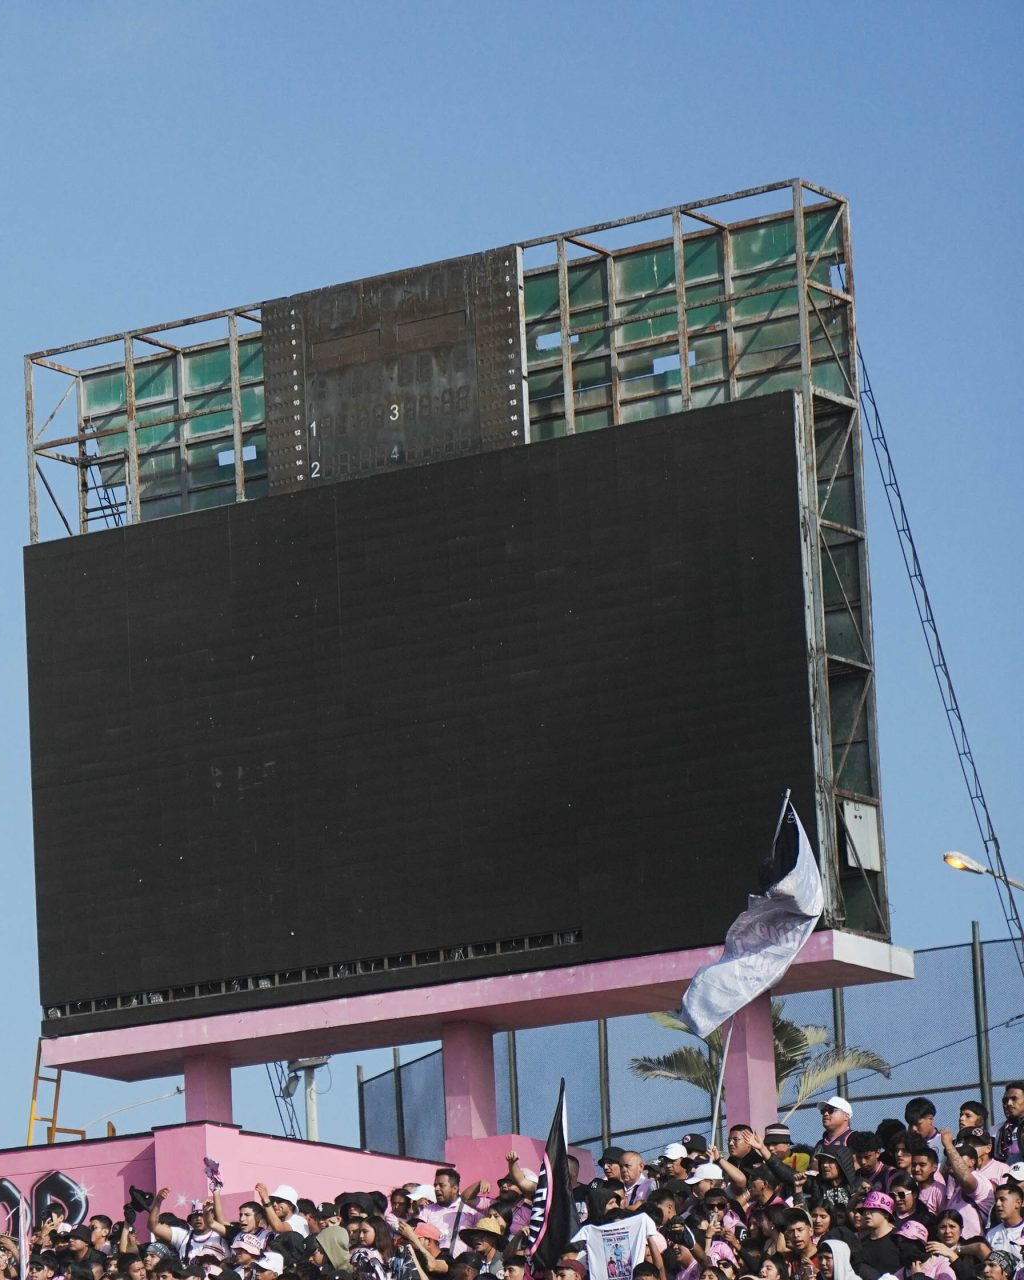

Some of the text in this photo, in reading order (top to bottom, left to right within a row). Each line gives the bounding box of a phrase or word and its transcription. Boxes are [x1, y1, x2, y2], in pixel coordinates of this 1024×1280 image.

[389, 404, 399, 421] 3
[310, 420, 316, 437] 1
[390, 445, 399, 460] 4
[311, 461, 321, 478] 2
